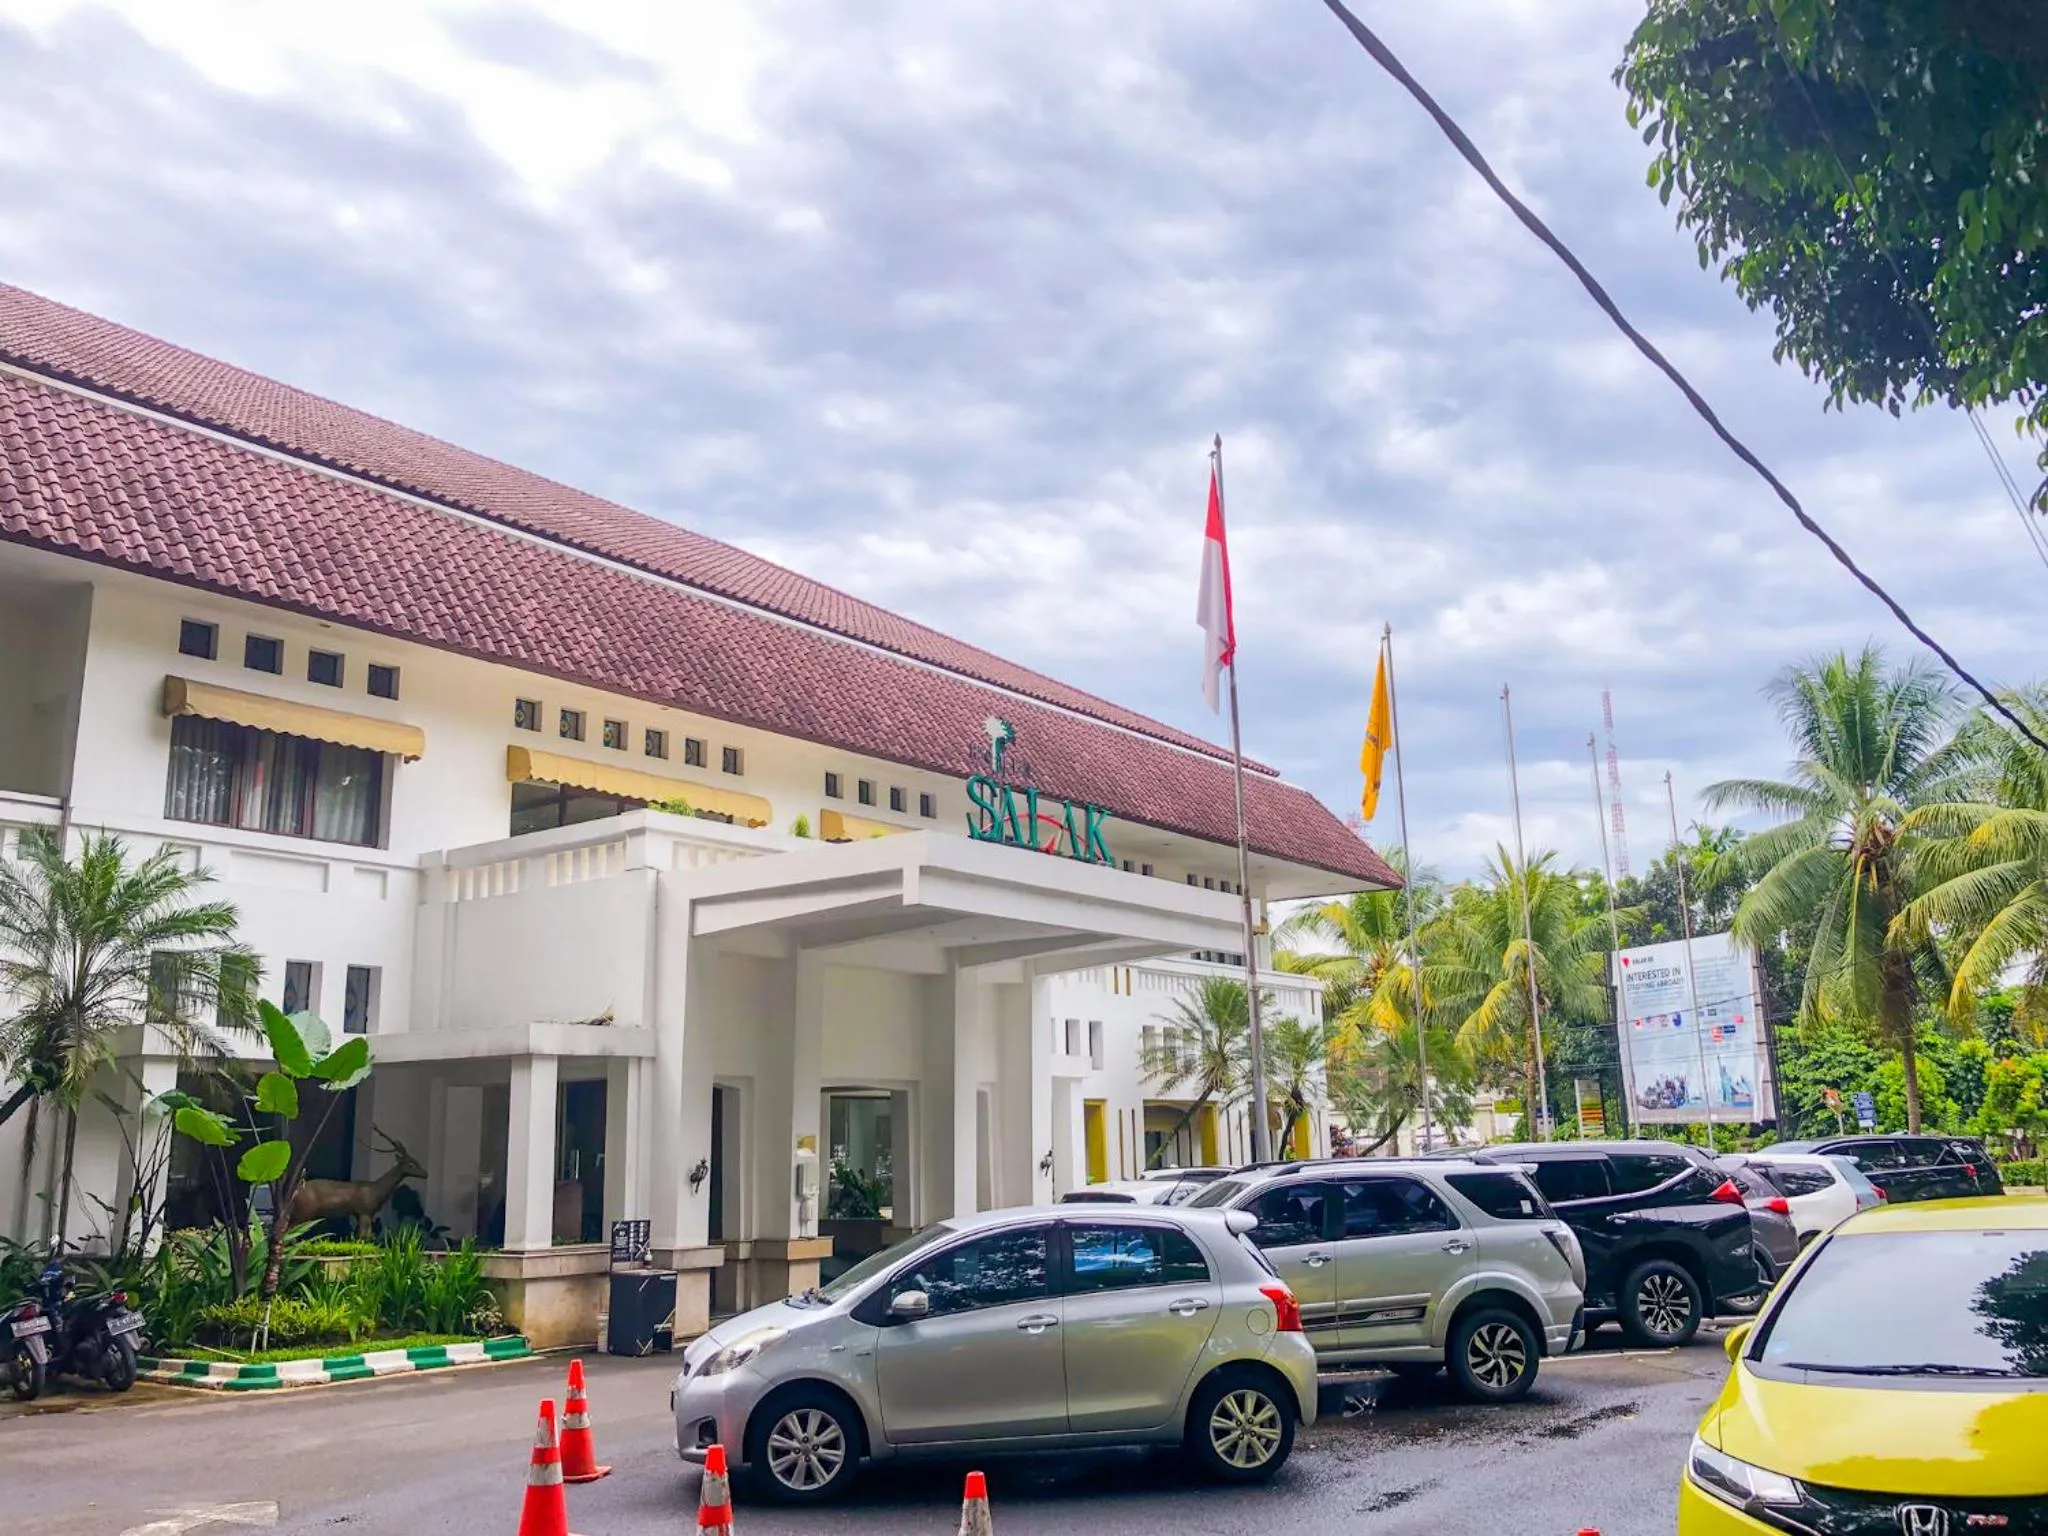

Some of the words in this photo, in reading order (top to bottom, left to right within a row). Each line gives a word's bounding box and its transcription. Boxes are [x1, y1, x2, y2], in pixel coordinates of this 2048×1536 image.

[966, 774, 1116, 868] SALAK
[1626, 967, 1670, 982] INTERESTED
[1672, 967, 1681, 976] IN
